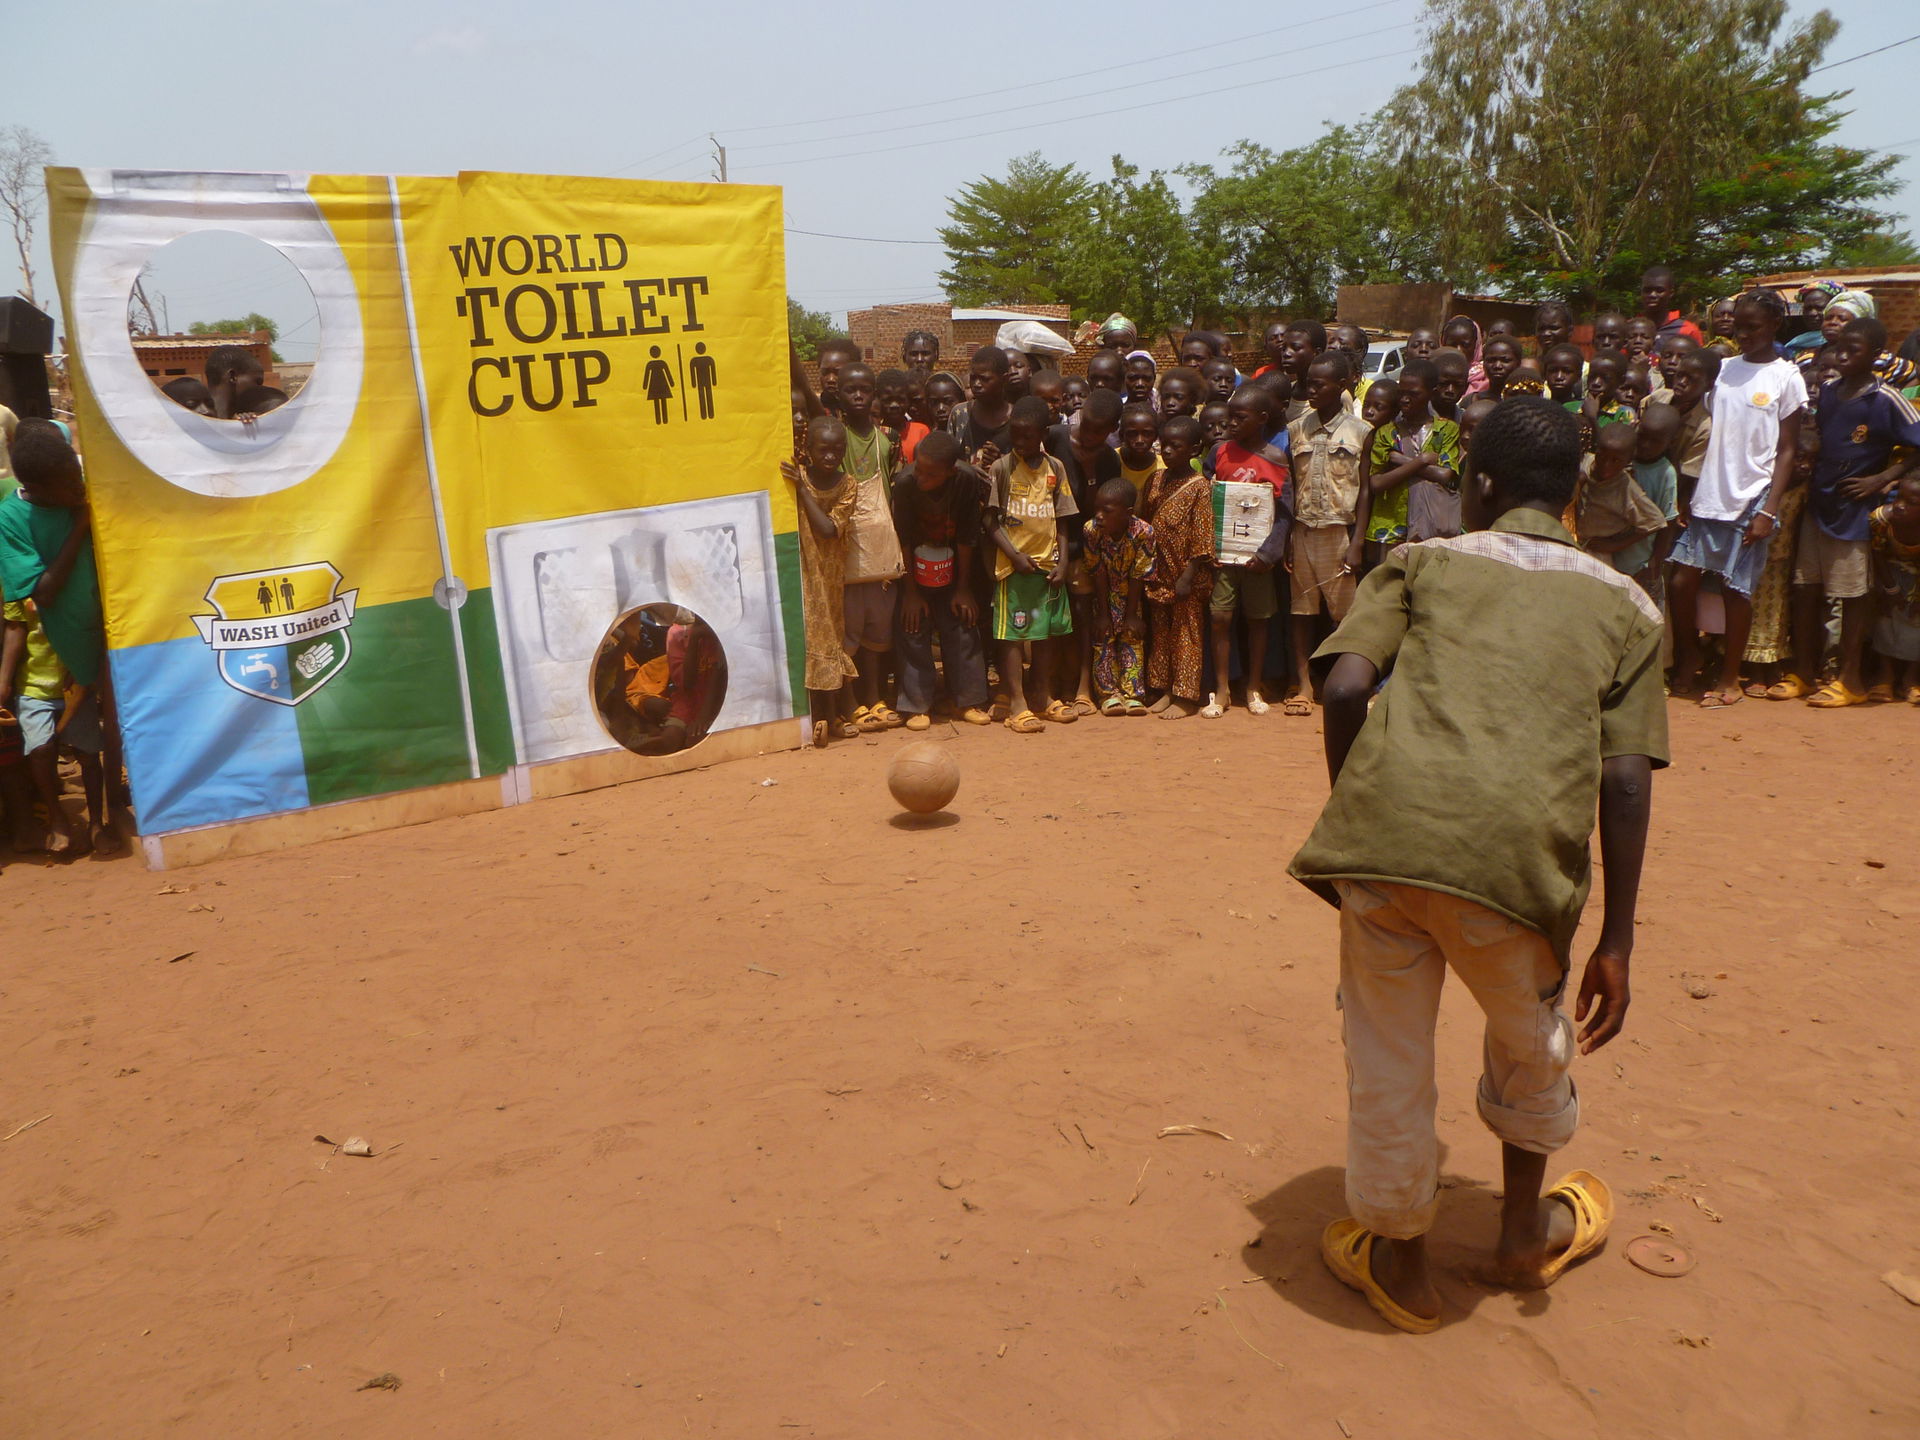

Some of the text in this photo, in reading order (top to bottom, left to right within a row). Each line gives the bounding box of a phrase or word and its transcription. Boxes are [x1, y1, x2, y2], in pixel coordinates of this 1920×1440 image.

[449, 233, 628, 284] WORLD
[456, 276, 709, 347] TOILET
[468, 350, 611, 417] CUP
[220, 609, 341, 642] WASH United
